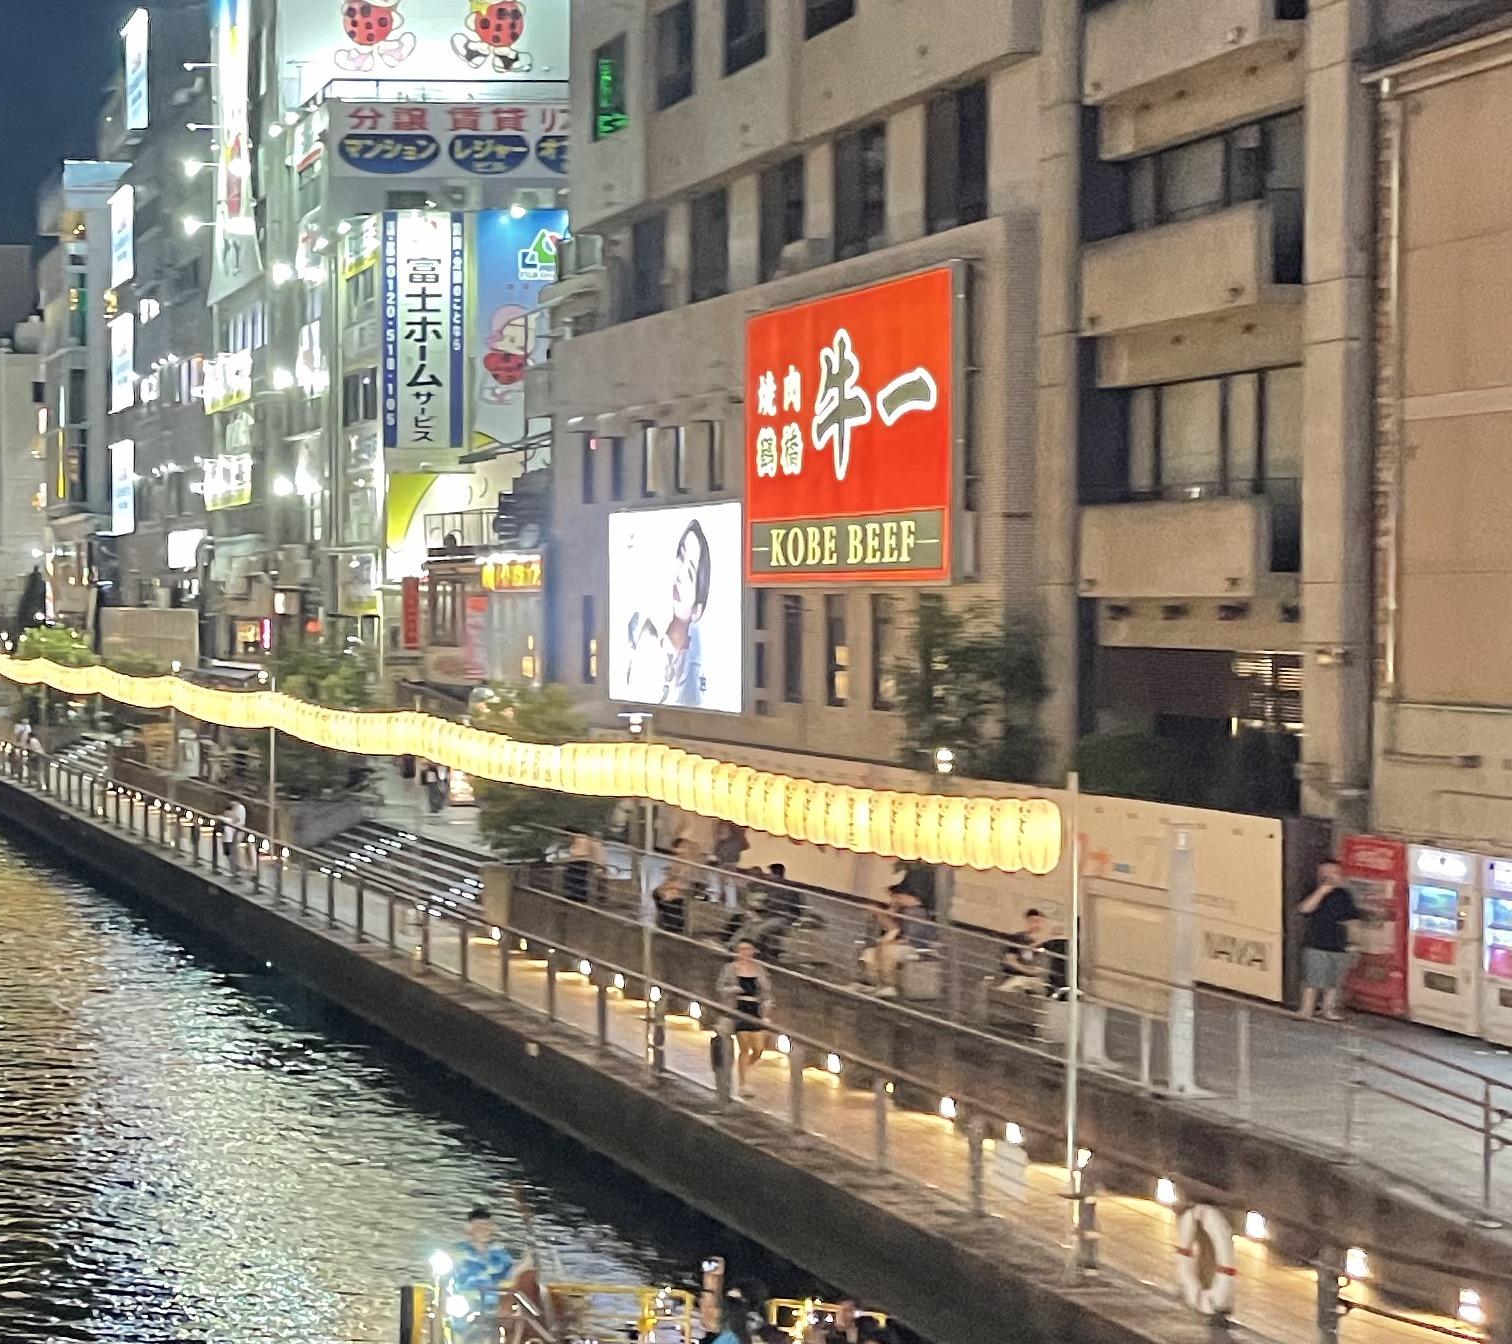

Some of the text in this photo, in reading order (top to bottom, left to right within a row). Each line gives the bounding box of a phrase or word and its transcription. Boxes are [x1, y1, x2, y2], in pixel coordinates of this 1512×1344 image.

[343, 137, 438, 160] マンション
[453, 137, 529, 160] レジャー
[757, 365, 801, 416] 焼肉
[770, 520, 916, 567] KOBE BEEF
